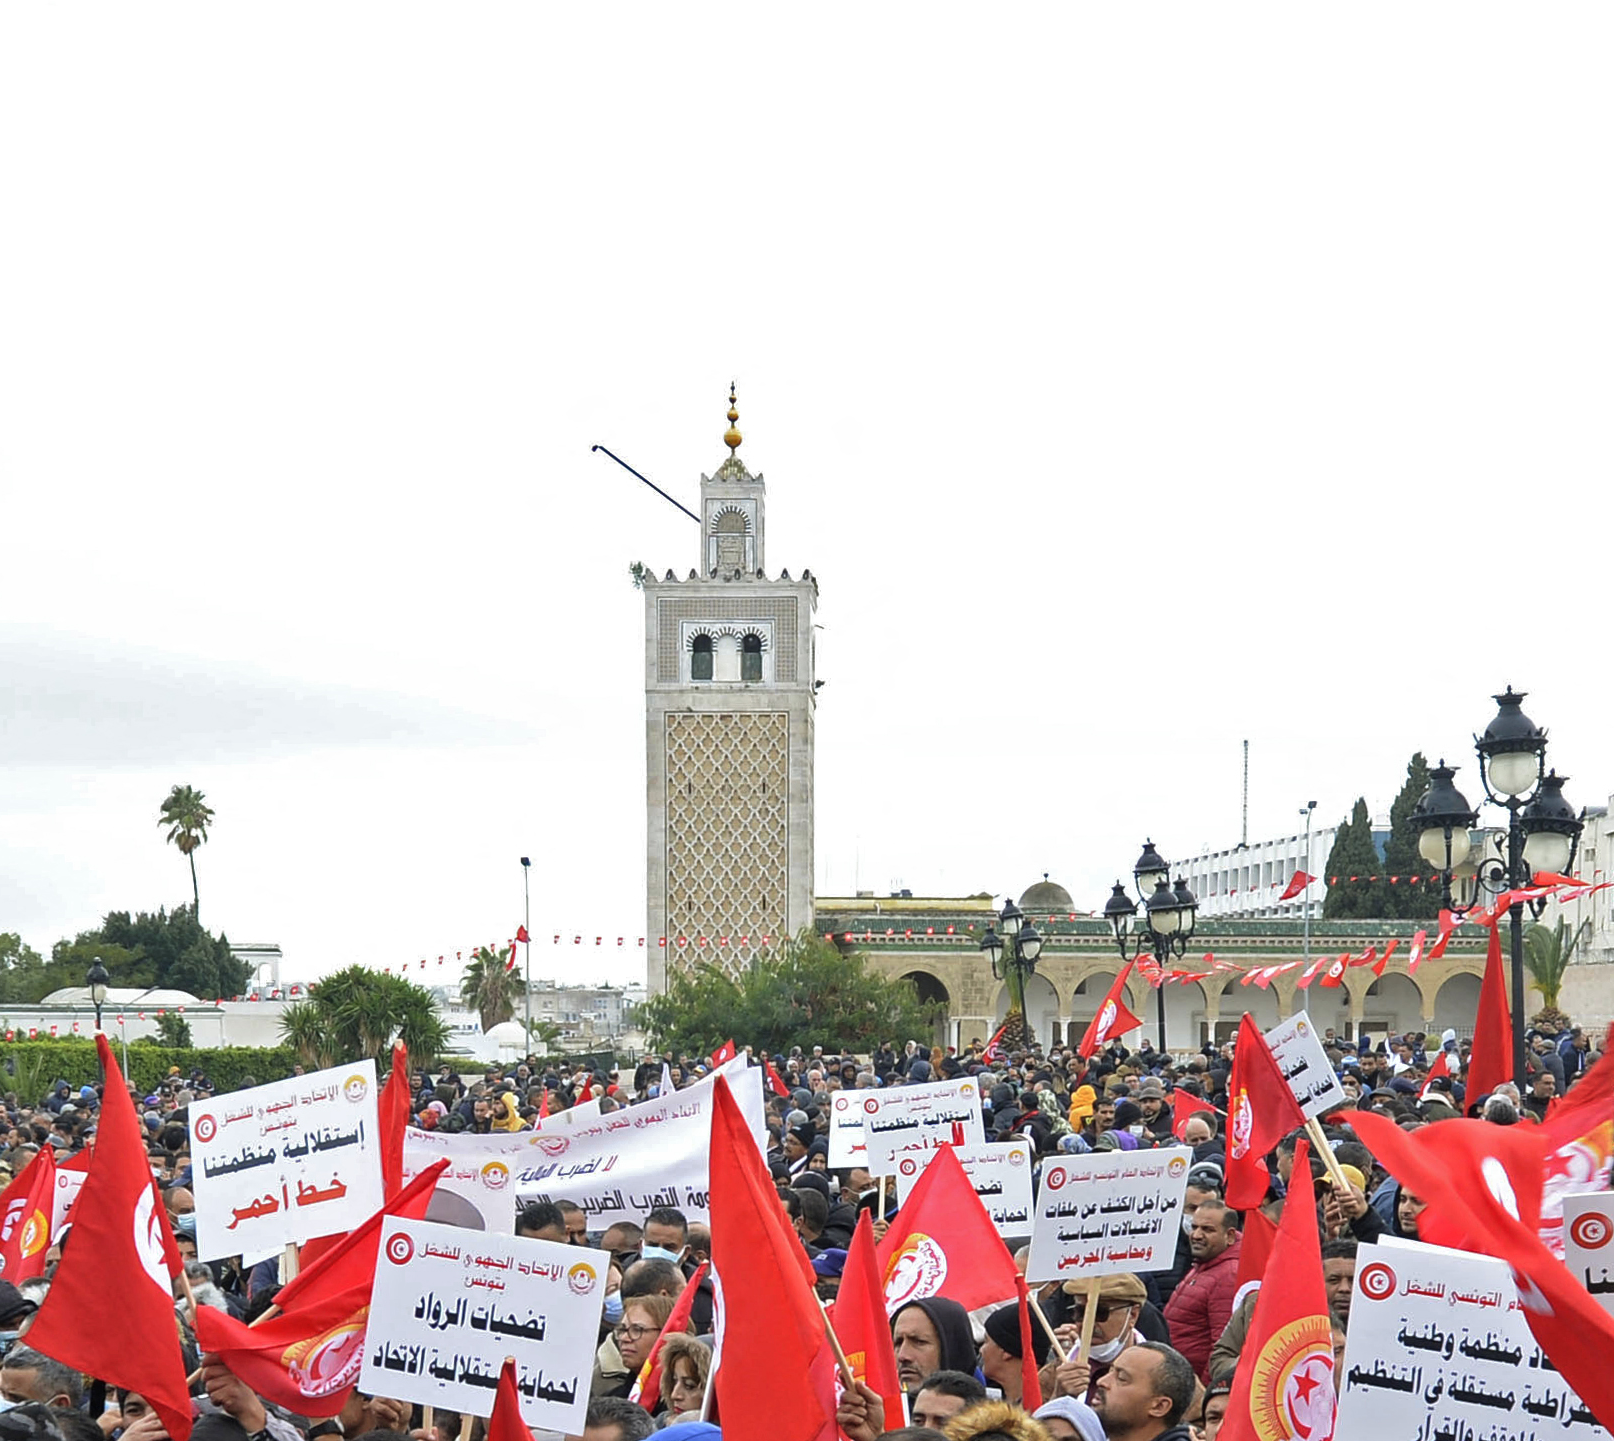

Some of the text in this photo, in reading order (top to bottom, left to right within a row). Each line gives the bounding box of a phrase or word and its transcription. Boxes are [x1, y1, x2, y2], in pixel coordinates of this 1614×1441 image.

[204, 1120, 365, 1178] إستقلالية منظمتنا
[226, 1175, 289, 1229] أحمر
[1081, 1202, 1097, 1220] عن
[1137, 1189, 1160, 1214] أجل
[1160, 1196, 1178, 1214] من
[1057, 1223, 1109, 1246] السياسية
[1058, 1244, 1153, 1270] ومحاسبة المجرمين
[414, 1292, 547, 1341] تضحيات الرواد
[372, 1340, 426, 1377] الاتحاد
[1397, 1318, 1455, 1361] وطنية
[1458, 1327, 1523, 1367] منظمة
[517, 1364, 578, 1405] لحماية
[1346, 1359, 1516, 1413] مستقلة في التنظيم
